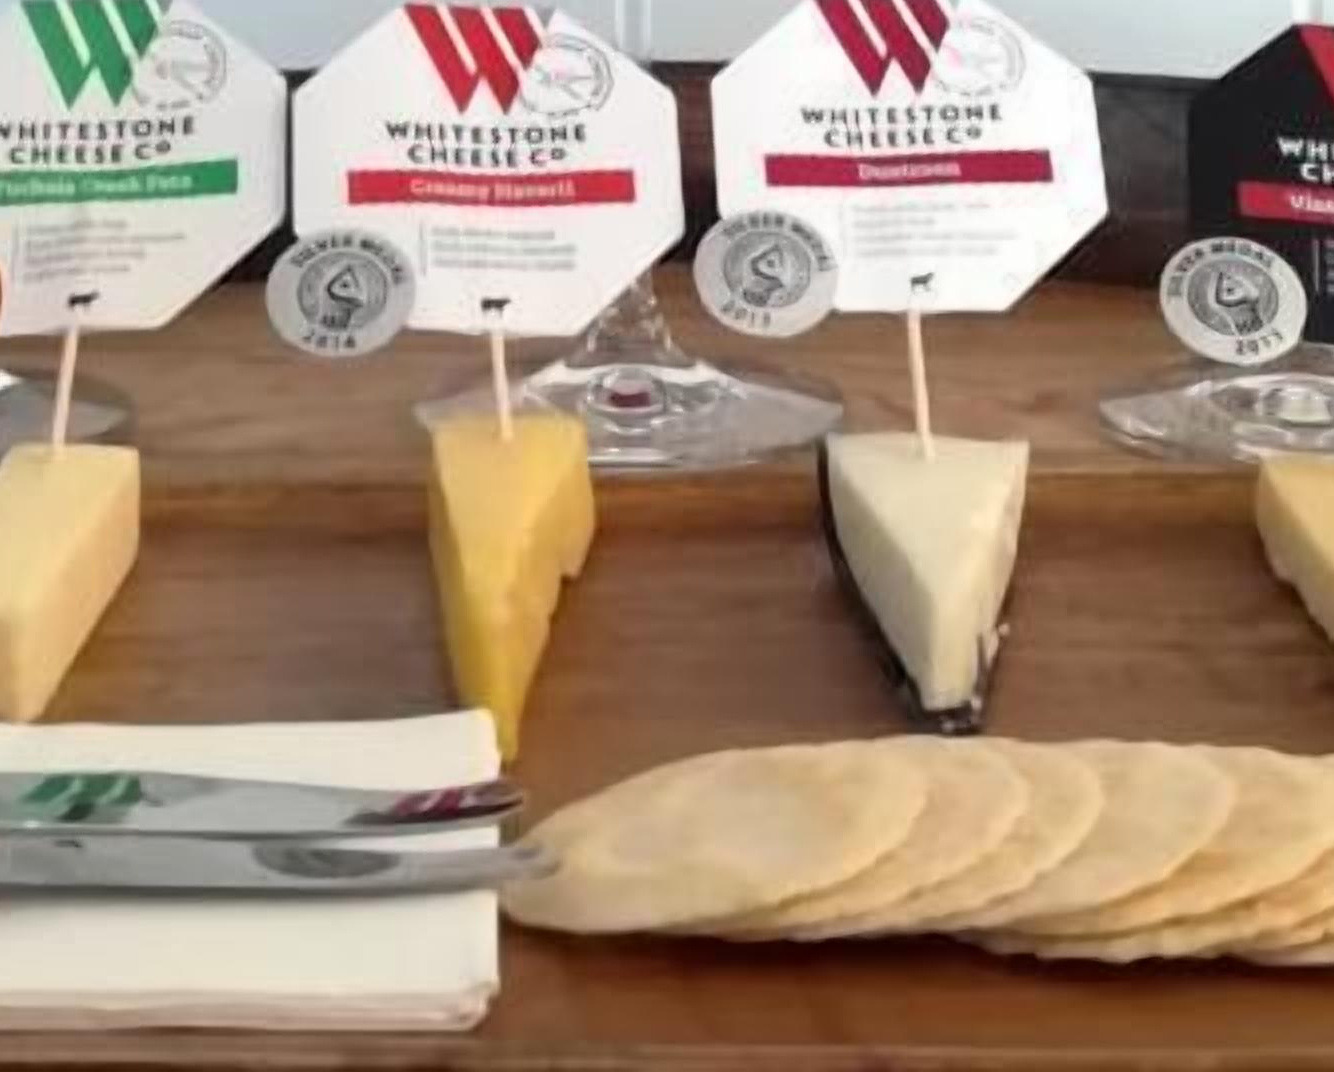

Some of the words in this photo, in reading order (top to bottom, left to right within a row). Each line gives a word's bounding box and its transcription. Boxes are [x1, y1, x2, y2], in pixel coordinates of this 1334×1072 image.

[800, 103, 1002, 125] WHITESTONE
[386, 120, 586, 144] WHITESTONE
[824, 126, 935, 149] CHEESE
[9, 144, 123, 165] CHEESE
[407, 145, 517, 168] CHEESE
